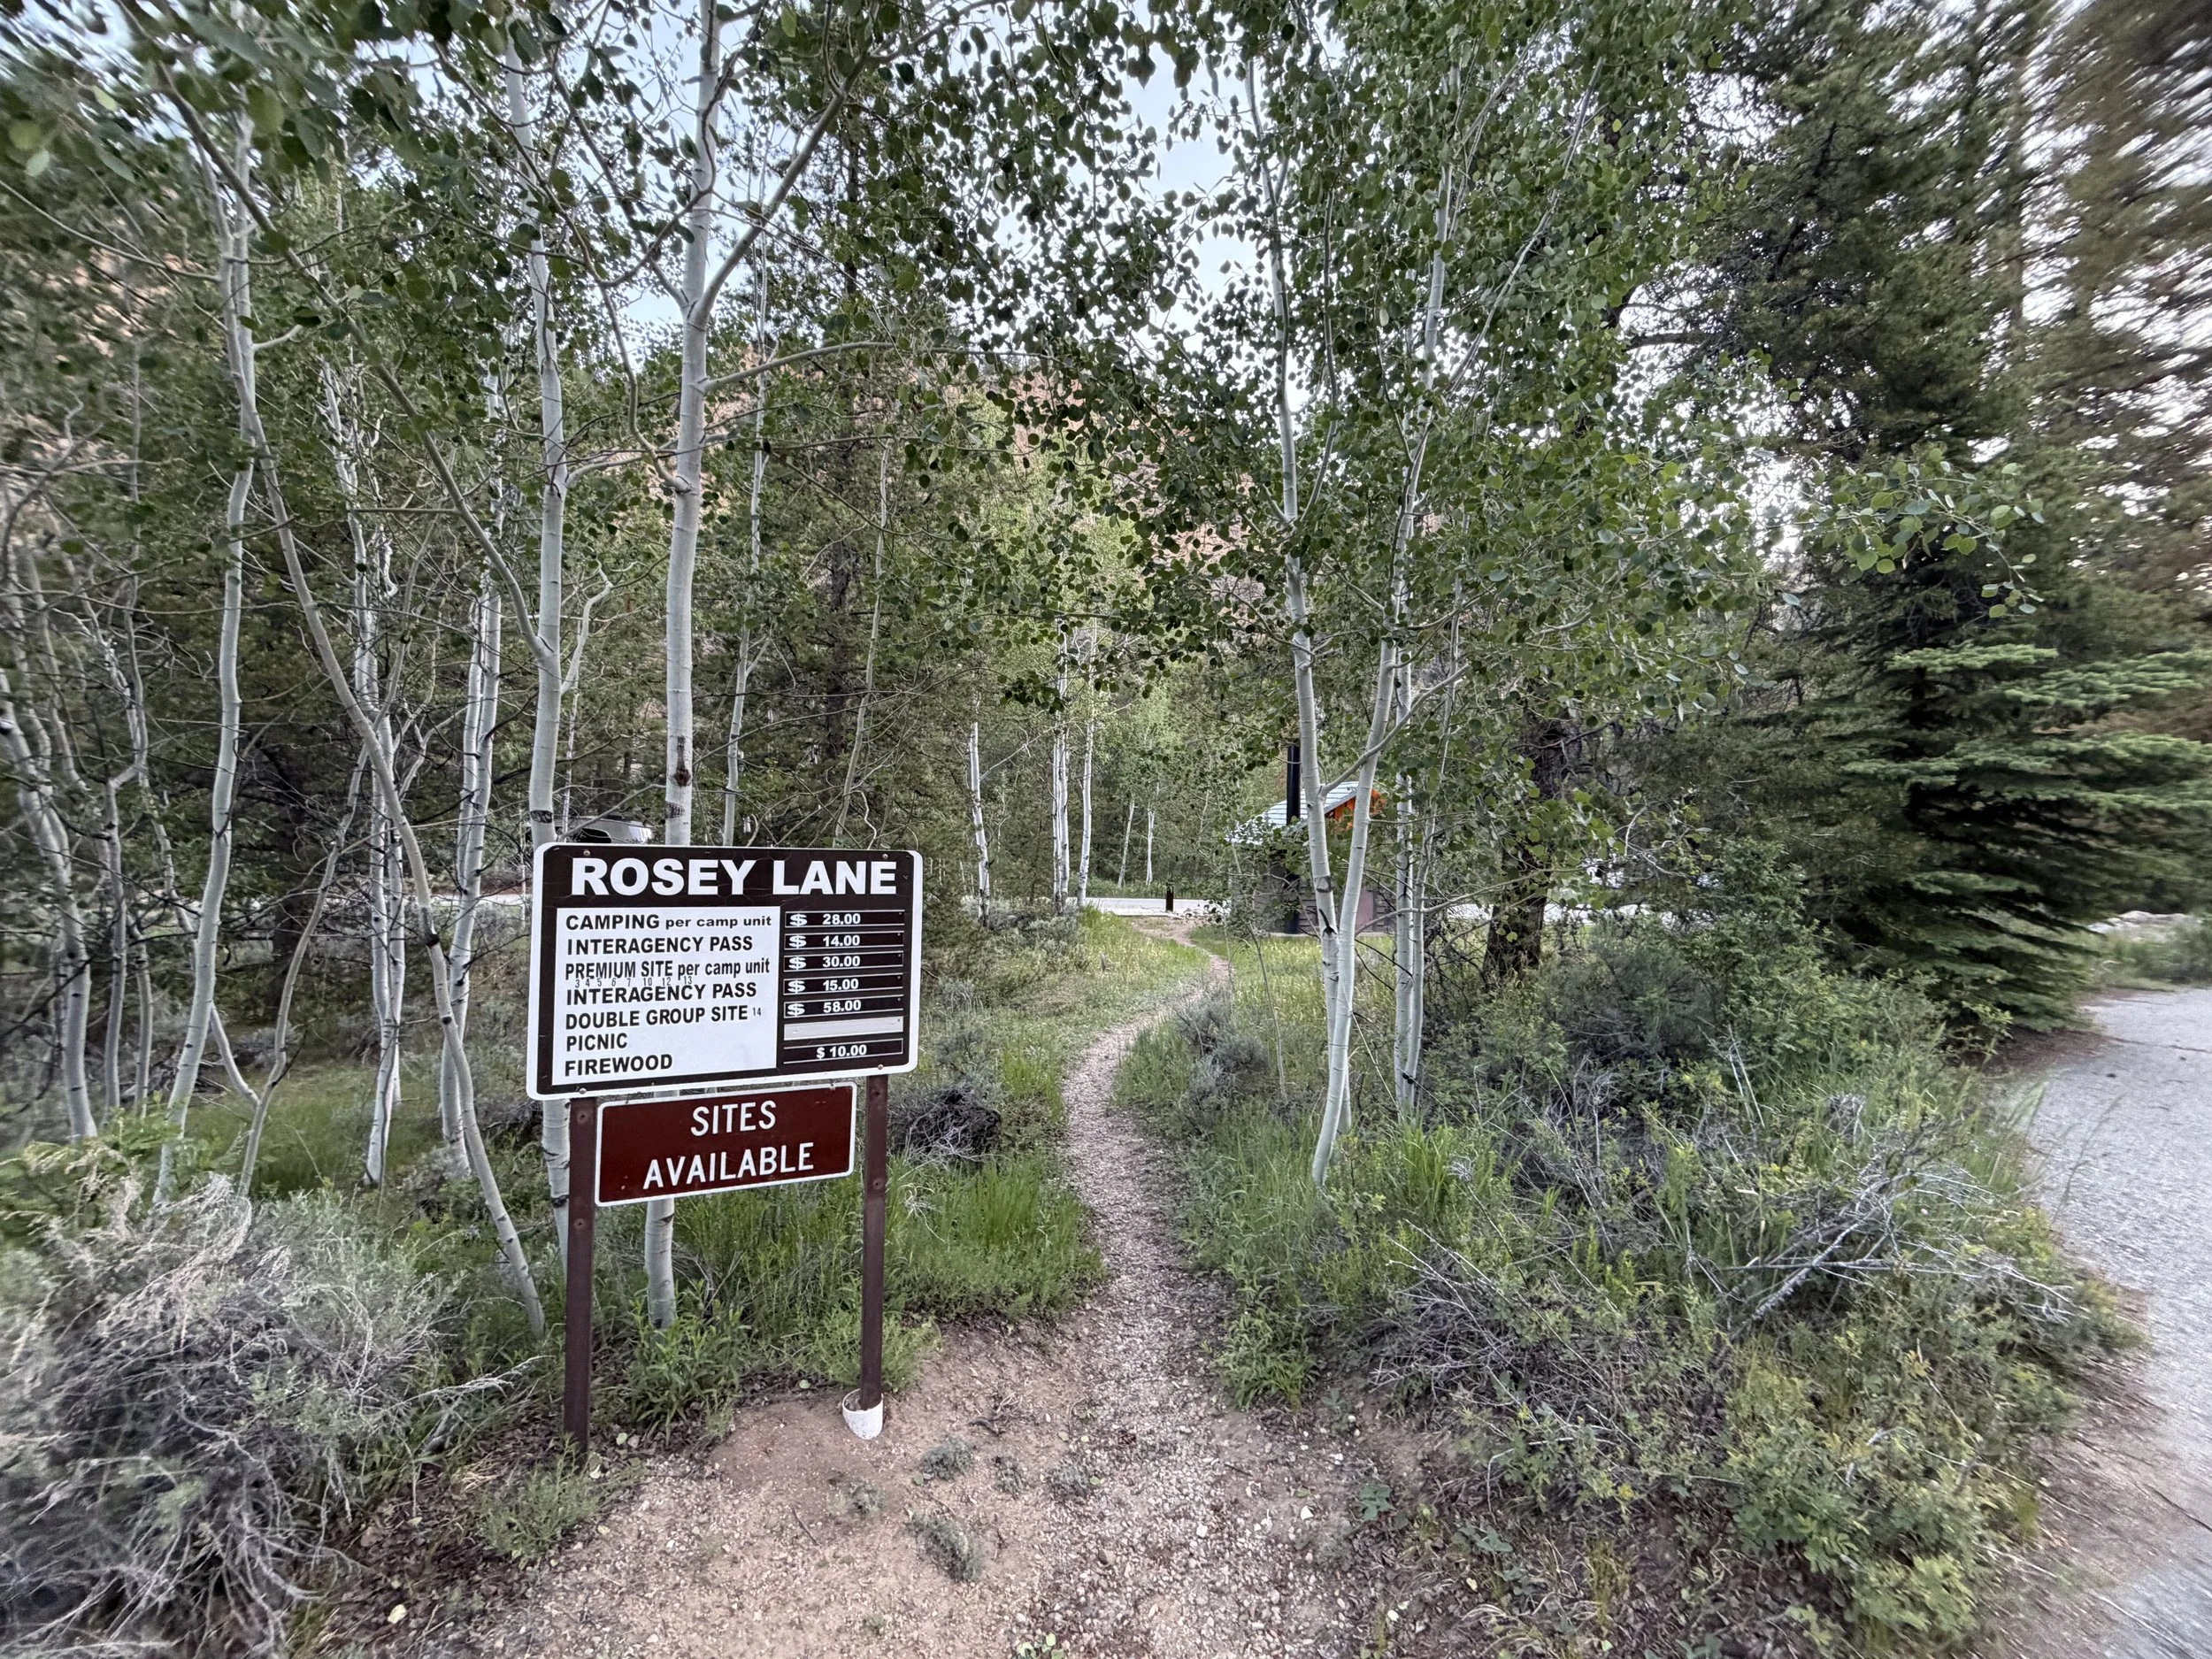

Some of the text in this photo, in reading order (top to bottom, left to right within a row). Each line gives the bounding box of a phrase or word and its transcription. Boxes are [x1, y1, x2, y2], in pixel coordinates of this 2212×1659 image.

[572, 857, 897, 895] ROSEY LANE
[565, 914, 772, 930] CAMPING per camp unit
[789, 913, 861, 927] $ 28.00
[567, 935, 753, 955] INTERAGENCY PASS
[788, 934, 860, 949] $ 14.00
[565, 957, 771, 980] PREMIUM SITE per camp unit
[788, 956, 861, 971] $ 30.00
[575, 975, 693, 988] 3 4 5 6 7 10 12 13
[787, 978, 859, 994] $ 15.00
[566, 982, 757, 1005] INTERAGENCY PASS
[787, 999, 862, 1017] $ 58.00
[565, 1005, 762, 1030] DOUBLE GROUP SITE 14
[566, 1033, 627, 1051] PICNIC
[816, 1044, 867, 1059] $ 10.00
[565, 1054, 672, 1076] FIREWOOD
[690, 1100, 776, 1136] SITES
[642, 1142, 814, 1189] AVAILABLE
